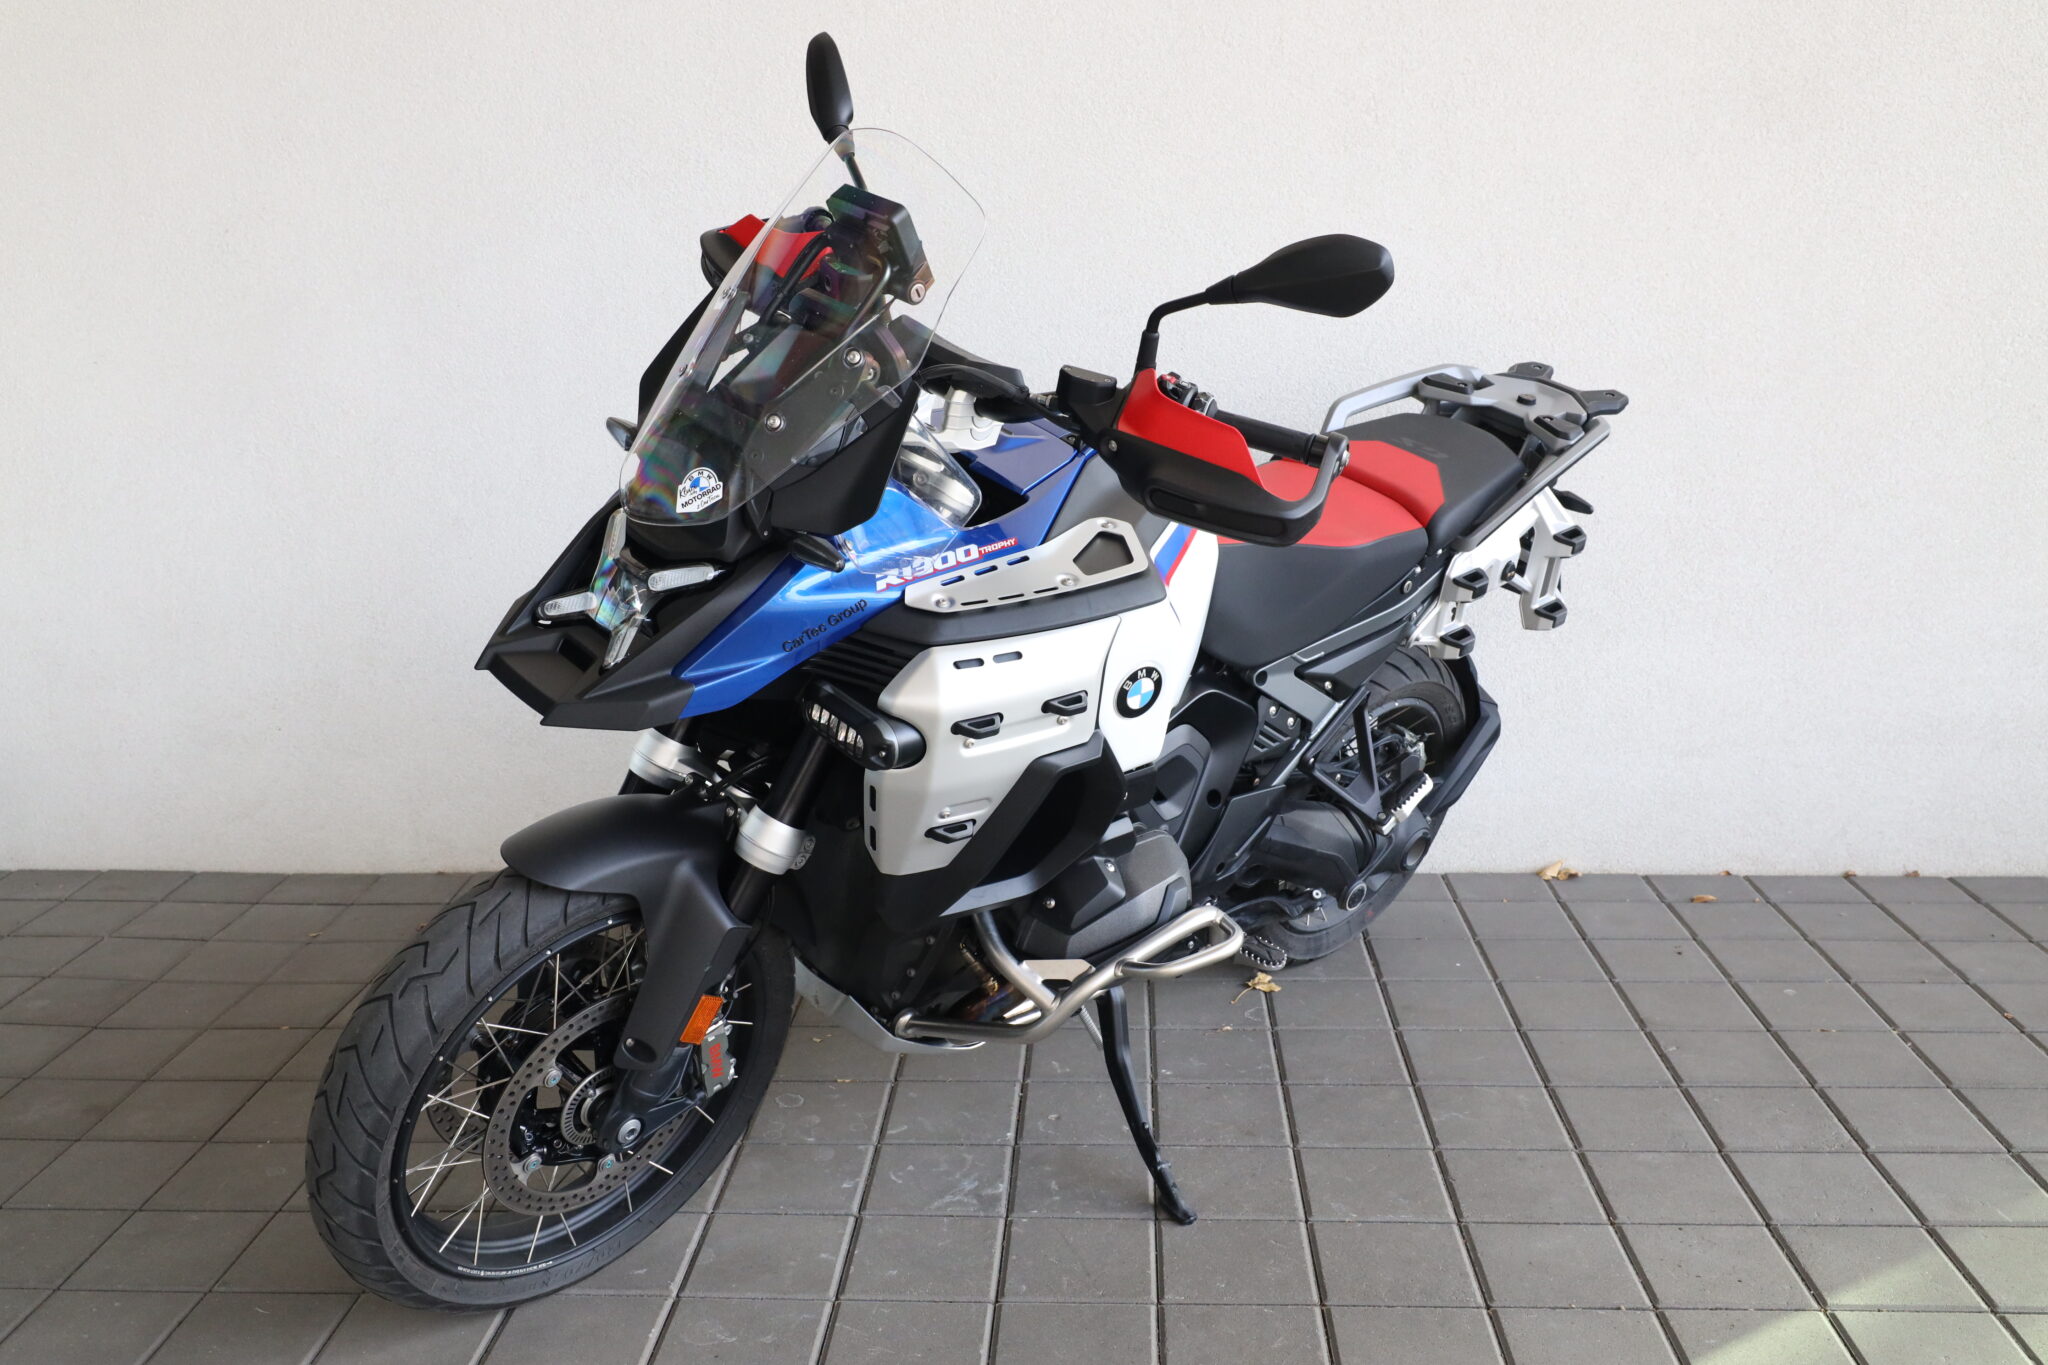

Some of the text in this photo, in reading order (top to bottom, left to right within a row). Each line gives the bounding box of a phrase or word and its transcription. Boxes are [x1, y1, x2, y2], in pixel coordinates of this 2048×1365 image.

[688, 471, 713, 482] BMW
[681, 483, 722, 509] MOTORRAD
[876, 537, 1017, 592] R1300 TROPHY
[782, 598, 868, 653] CarTec Group
[1123, 668, 1160, 691] BMW
